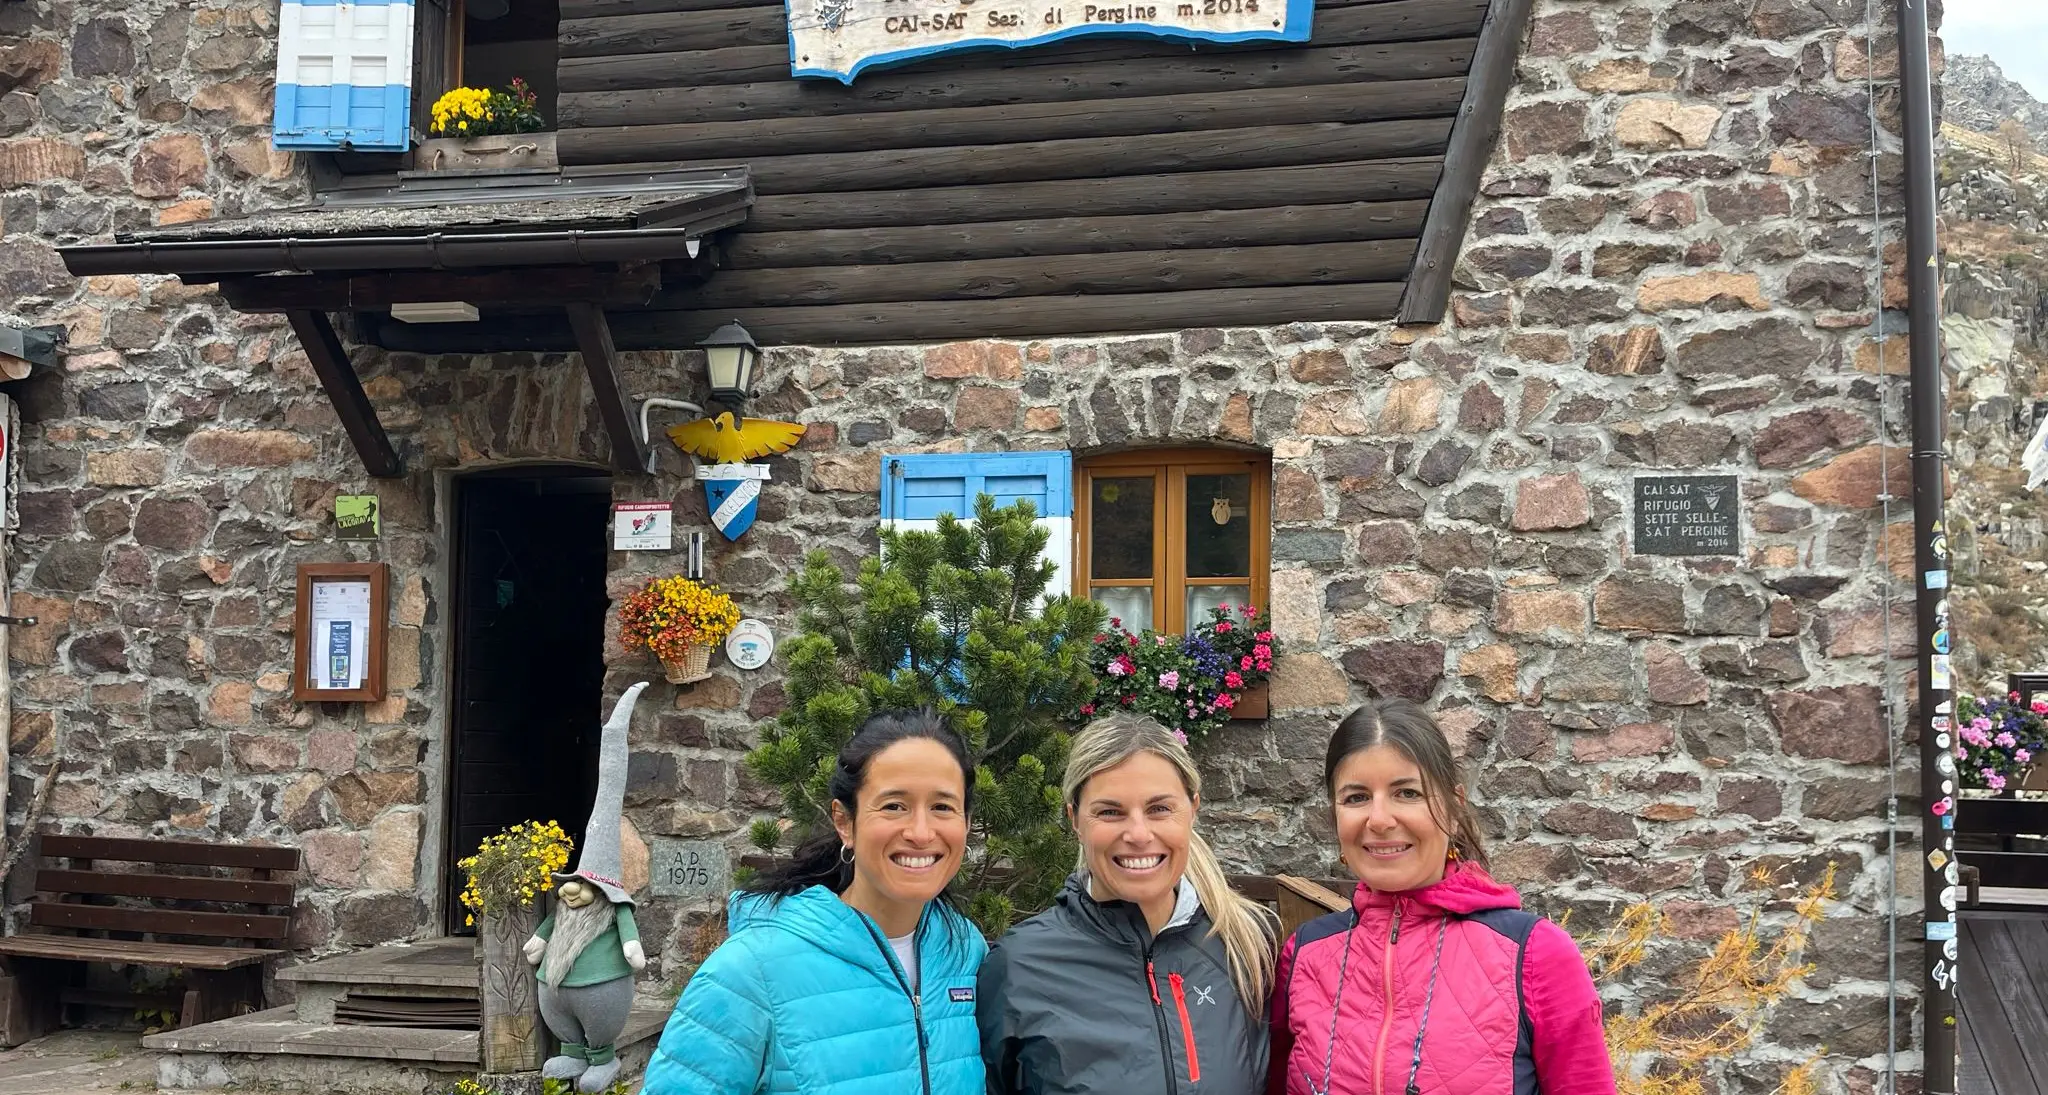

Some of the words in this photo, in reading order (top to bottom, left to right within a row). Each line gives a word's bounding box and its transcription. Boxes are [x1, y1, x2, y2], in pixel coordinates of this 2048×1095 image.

[885, 12, 968, 34] CAI-SAT
[987, 10, 1025, 28] Sez.
[1044, 6, 1063, 25] di
[1084, 4, 1157, 24] Pergine
[1643, 500, 1691, 511] RIFUGIO
[1644, 513, 1679, 524] SETTE
[1645, 526, 1672, 537] SAT
[1680, 525, 1729, 537] PERGINE
[1707, 538, 1729, 547] 2014
[668, 867, 709, 886] 1975
